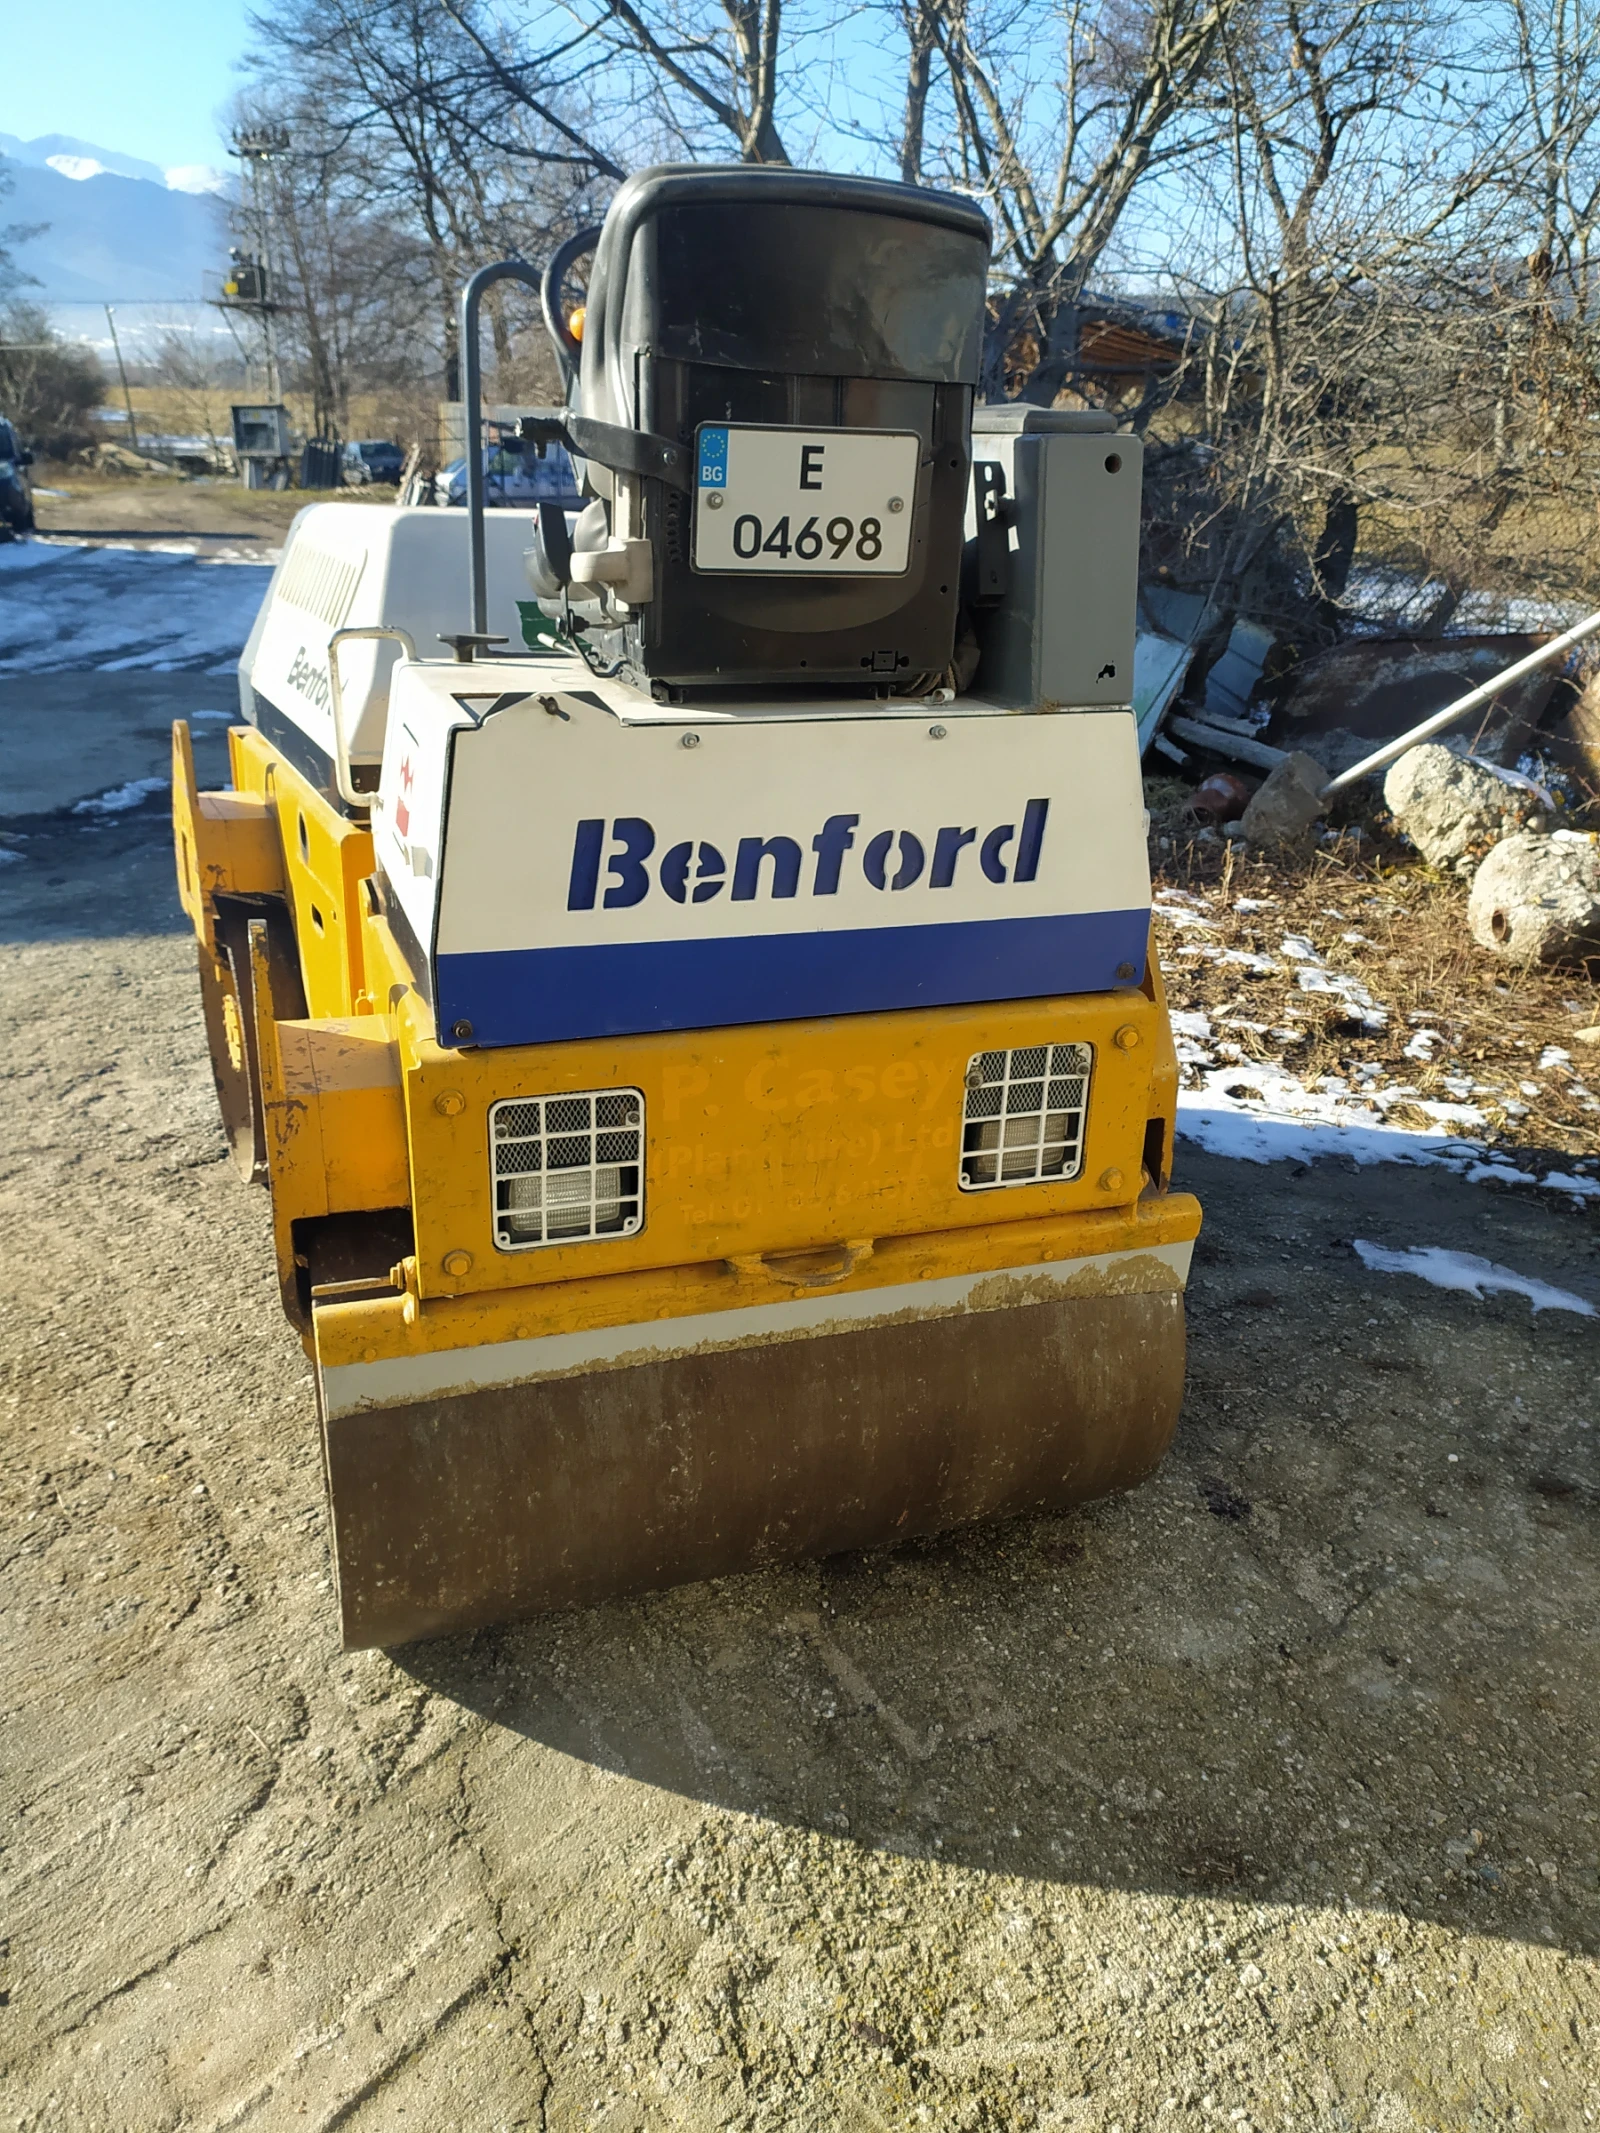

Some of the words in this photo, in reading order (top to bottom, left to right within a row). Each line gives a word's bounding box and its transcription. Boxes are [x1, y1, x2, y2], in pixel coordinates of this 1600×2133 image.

[702, 465, 723, 482] BG
[799, 445, 825, 491] E
[732, 514, 883, 561] 04698
[567, 797, 1052, 912] Benford
[661, 1063, 719, 1122] P.
[744, 1055, 961, 1112] Casey
[893, 1116, 955, 1154] Ltd
